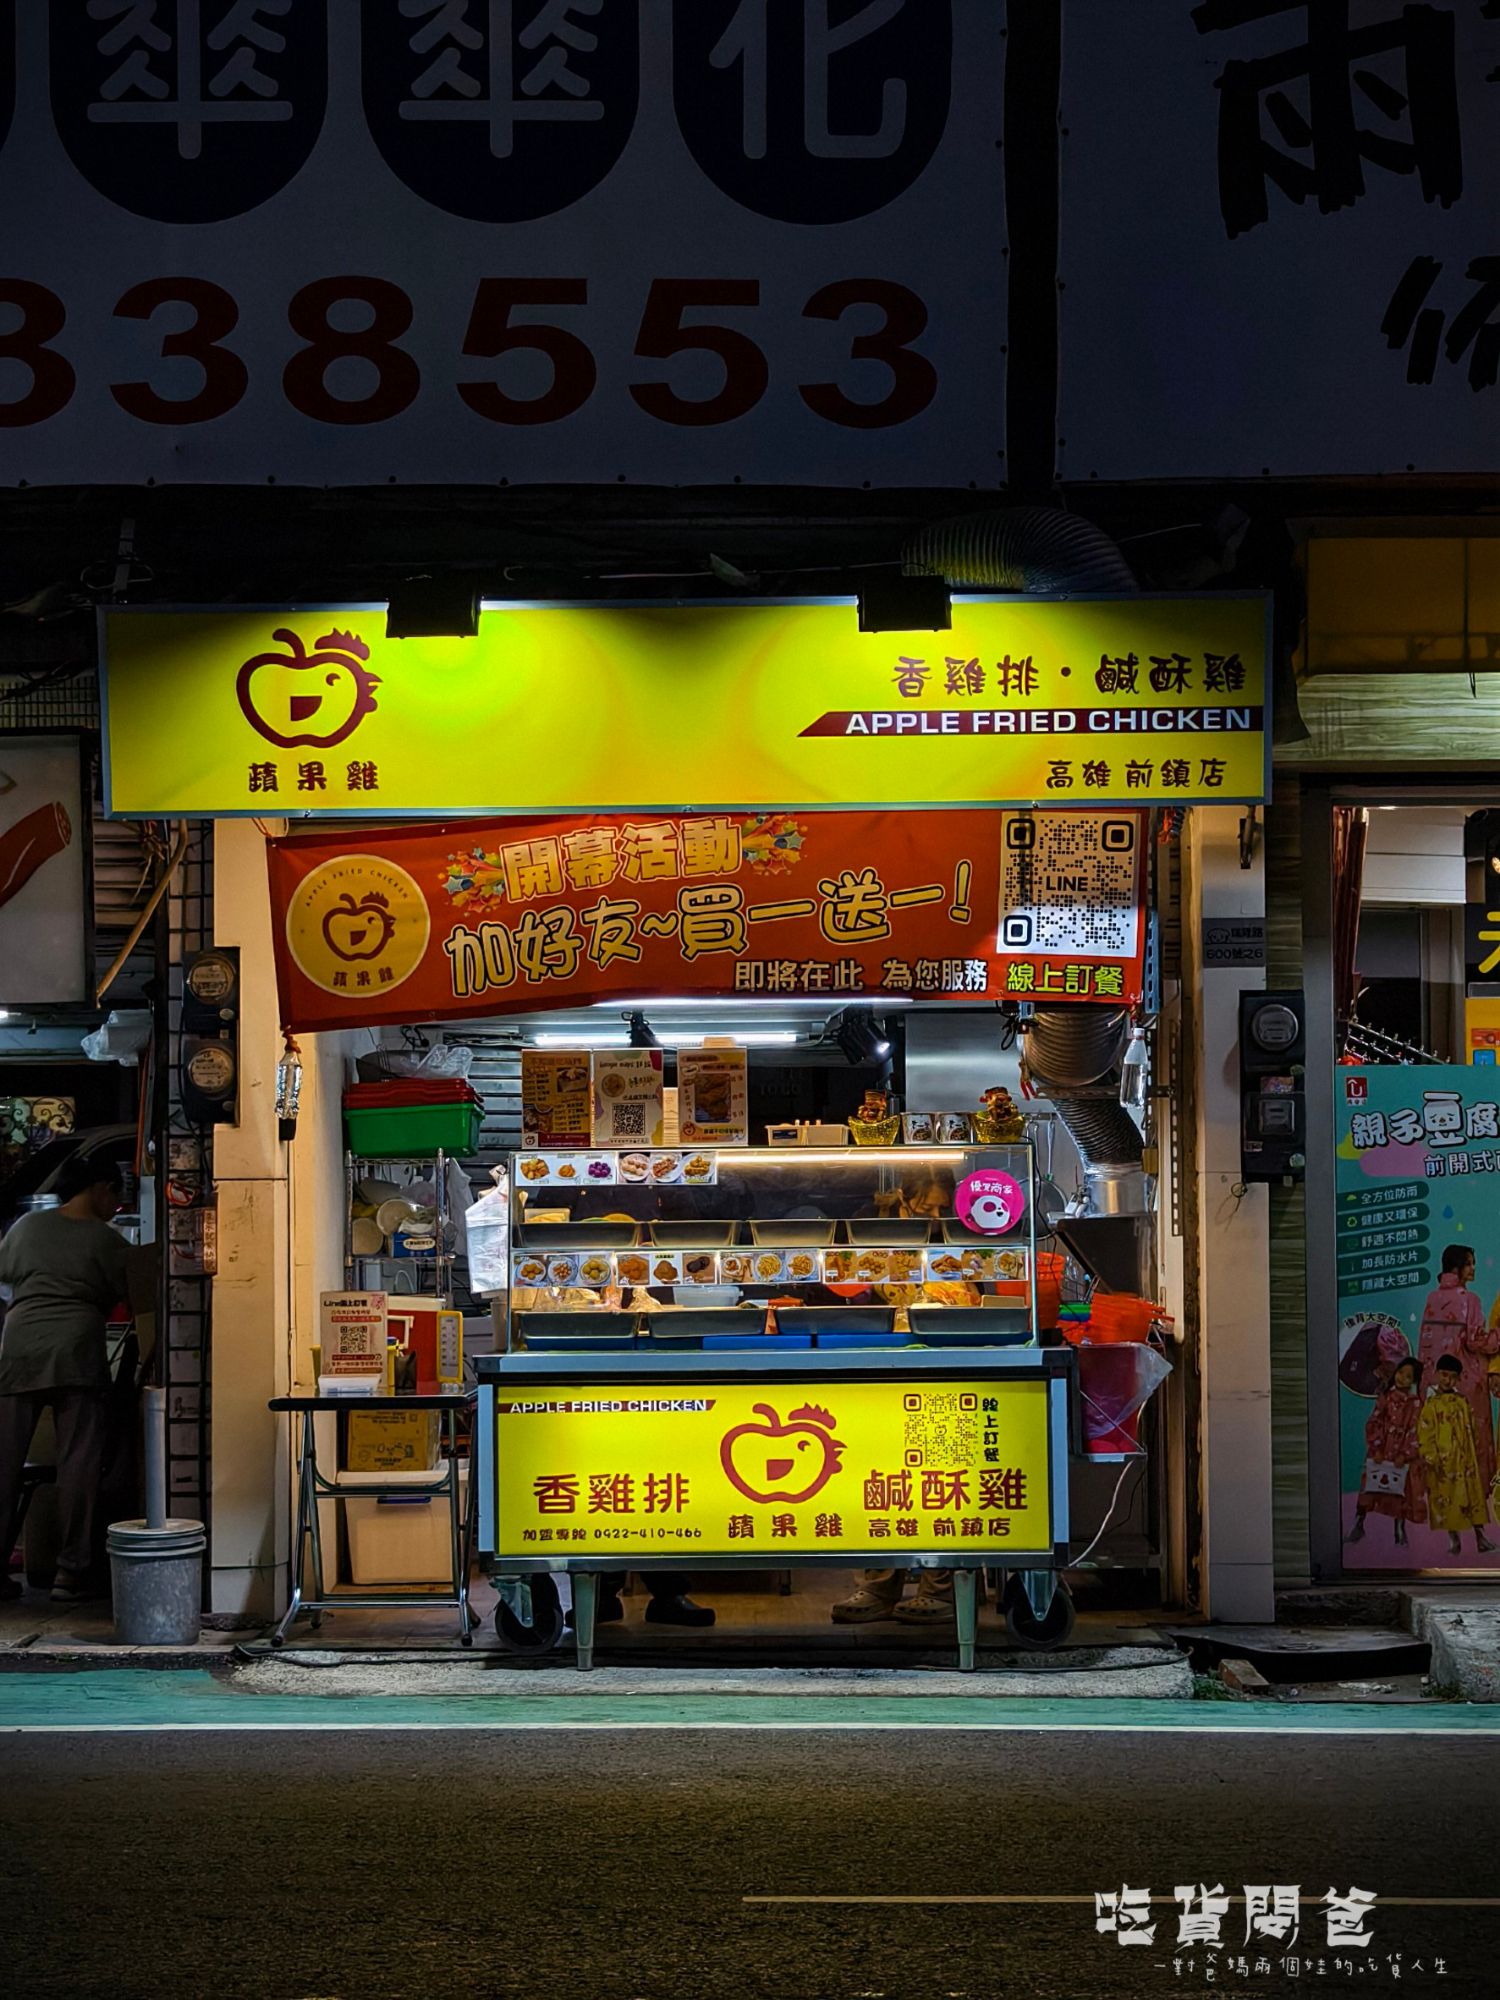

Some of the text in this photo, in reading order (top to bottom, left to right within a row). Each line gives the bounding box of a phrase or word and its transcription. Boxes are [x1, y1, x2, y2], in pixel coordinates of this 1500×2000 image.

[845, 708, 1252, 735] APPLE FRIED CHICKEN
[248, 760, 380, 793] 蘋果雞
[500, 816, 742, 903] 開幕活動
[1045, 876, 1089, 892] LINE
[332, 966, 395, 987] 蘋果雞
[735, 958, 988, 992] 即將在此 為您服務
[1007, 962, 1125, 996] 線上訂餐
[1424, 1151, 1500, 1177] 前開式
[1361, 1185, 1418, 1205] 全方位防雨
[1361, 1207, 1419, 1227] 健康又環保
[1361, 1250, 1419, 1270] 加長防水片
[510, 1399, 707, 1413] APPLE FRIED CHICKEN
[533, 1472, 690, 1515] 香雞排
[863, 1467, 1028, 1512] 鹹酥雞
[594, 1527, 702, 1540] 0922-410-466
[727, 1513, 844, 1539] 蘋果雞
